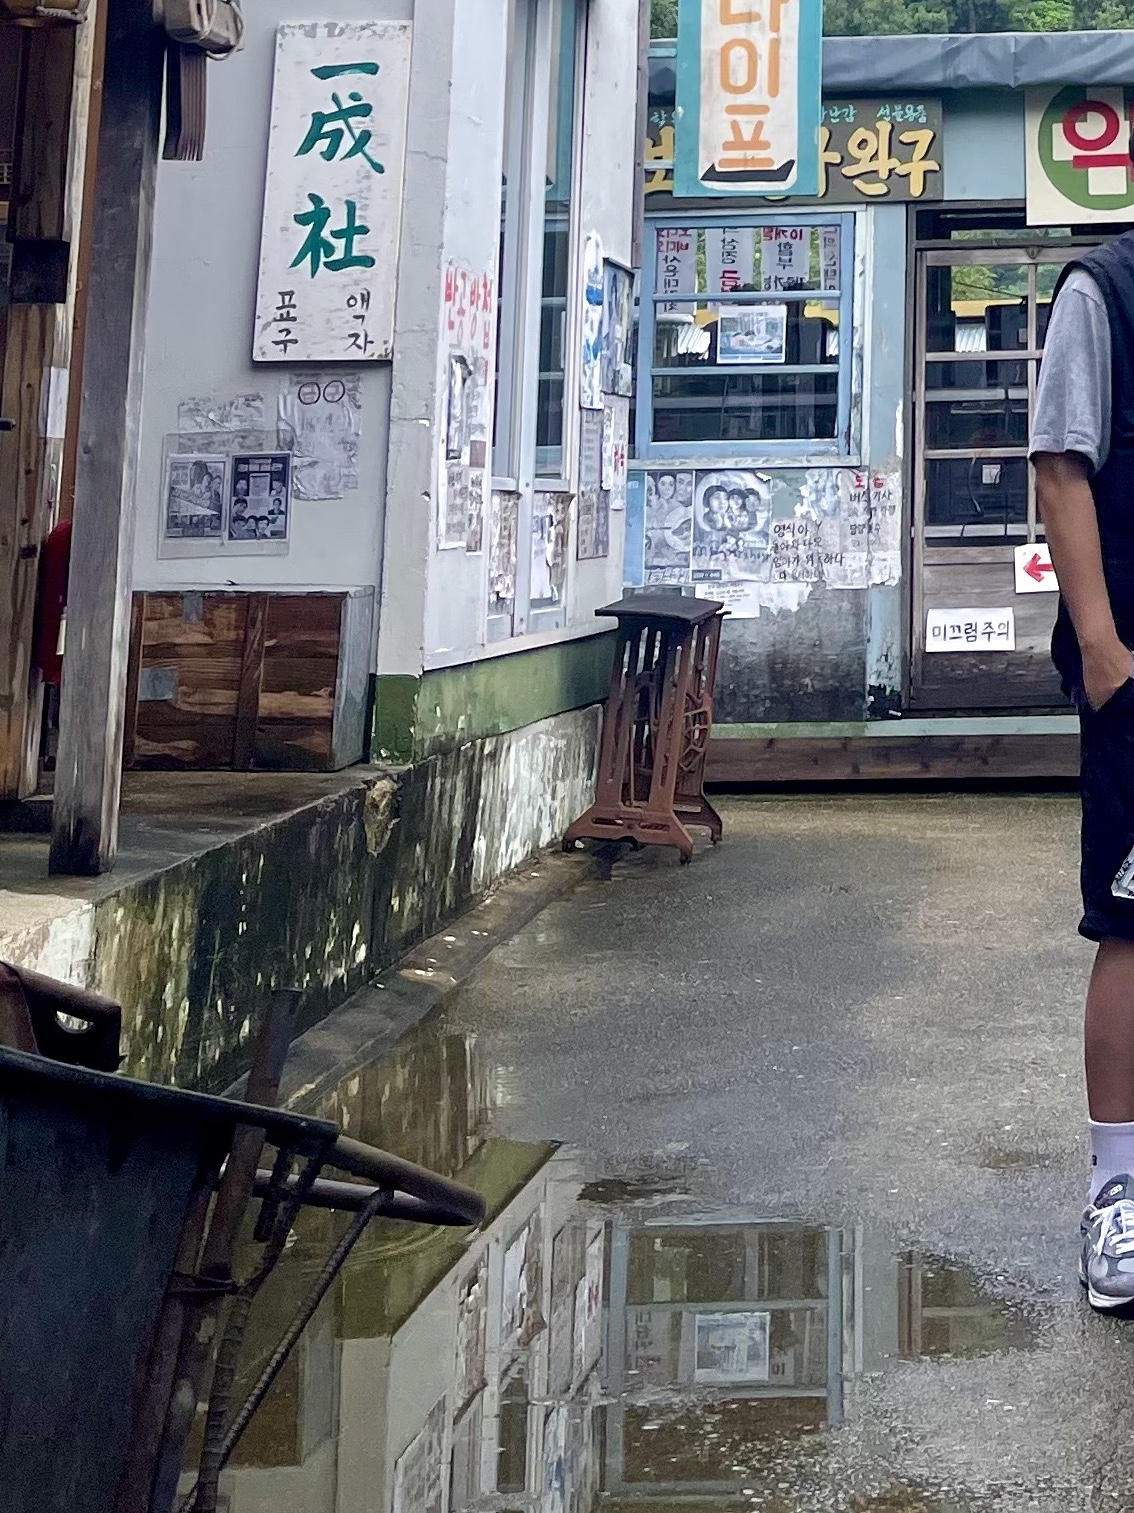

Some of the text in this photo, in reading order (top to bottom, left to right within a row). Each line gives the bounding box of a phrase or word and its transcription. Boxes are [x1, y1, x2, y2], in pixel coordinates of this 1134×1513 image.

[289, 62, 385, 278] 一成社
[346, 288, 375, 353] 액자
[444, 266, 492, 350] 반공방첩
